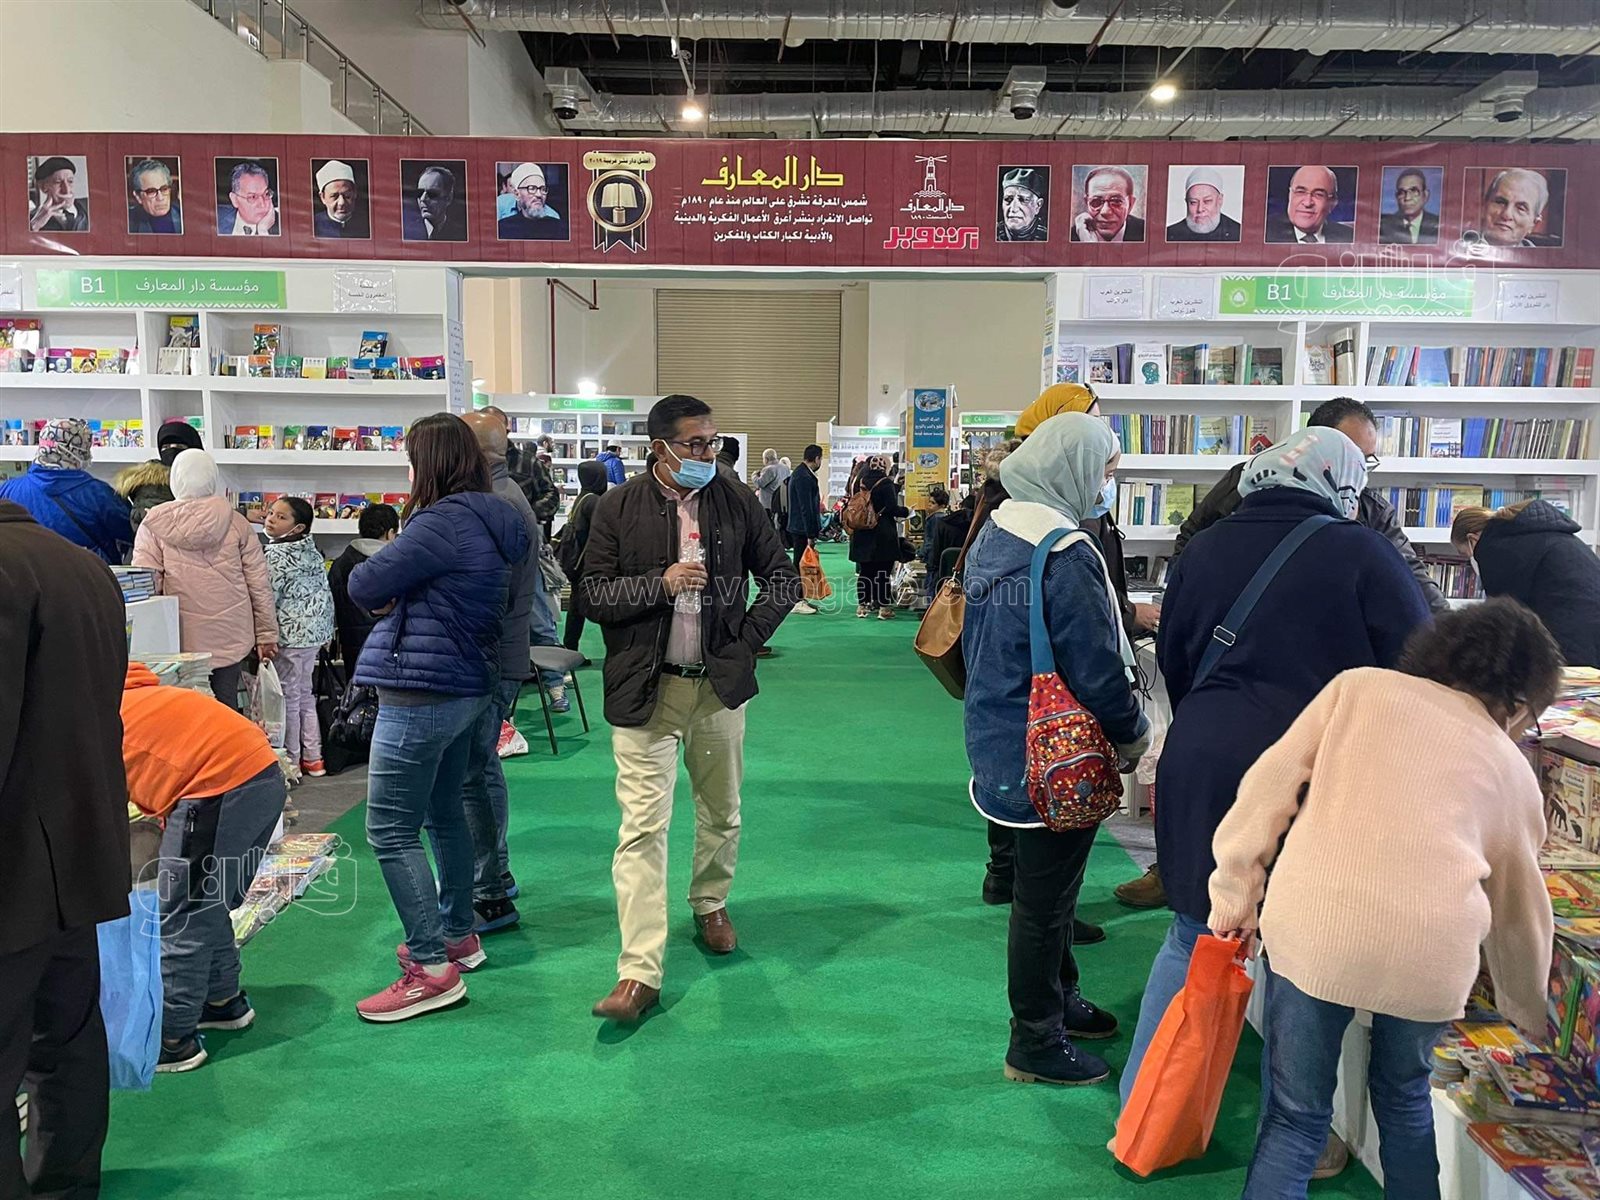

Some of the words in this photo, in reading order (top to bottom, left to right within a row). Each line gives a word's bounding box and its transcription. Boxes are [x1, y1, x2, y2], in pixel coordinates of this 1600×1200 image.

[700, 154, 799, 191] المعارف
[798, 154, 845, 191] دار
[709, 196, 725, 208] عام
[725, 195, 741, 206] منذ
[741, 196, 767, 208] العالم
[768, 196, 786, 208] على
[786, 194, 811, 208] تشرق
[811, 194, 840, 208] المعرفة
[840, 194, 868, 208] شمس
[673, 211, 707, 225] والدينية
[708, 211, 739, 225] الفكرية
[740, 210, 769, 224] الأعمال
[793, 211, 815, 226] بنشر
[713, 228, 751, 243] والمفكرين
[752, 230, 780, 243] الكتاب
[780, 230, 803, 243] لكبار
[803, 227, 833, 243] والأدبية
[80, 276, 106, 294] B1
[135, 276, 186, 293] المعارف
[188, 277, 205, 294] دار
[209, 278, 259, 295] مؤسسة
[1267, 283, 1292, 301] B1
[1322, 284, 1373, 301] المعارف
[1375, 285, 1394, 302] دار
[1398, 286, 1447, 302] مؤسسة
